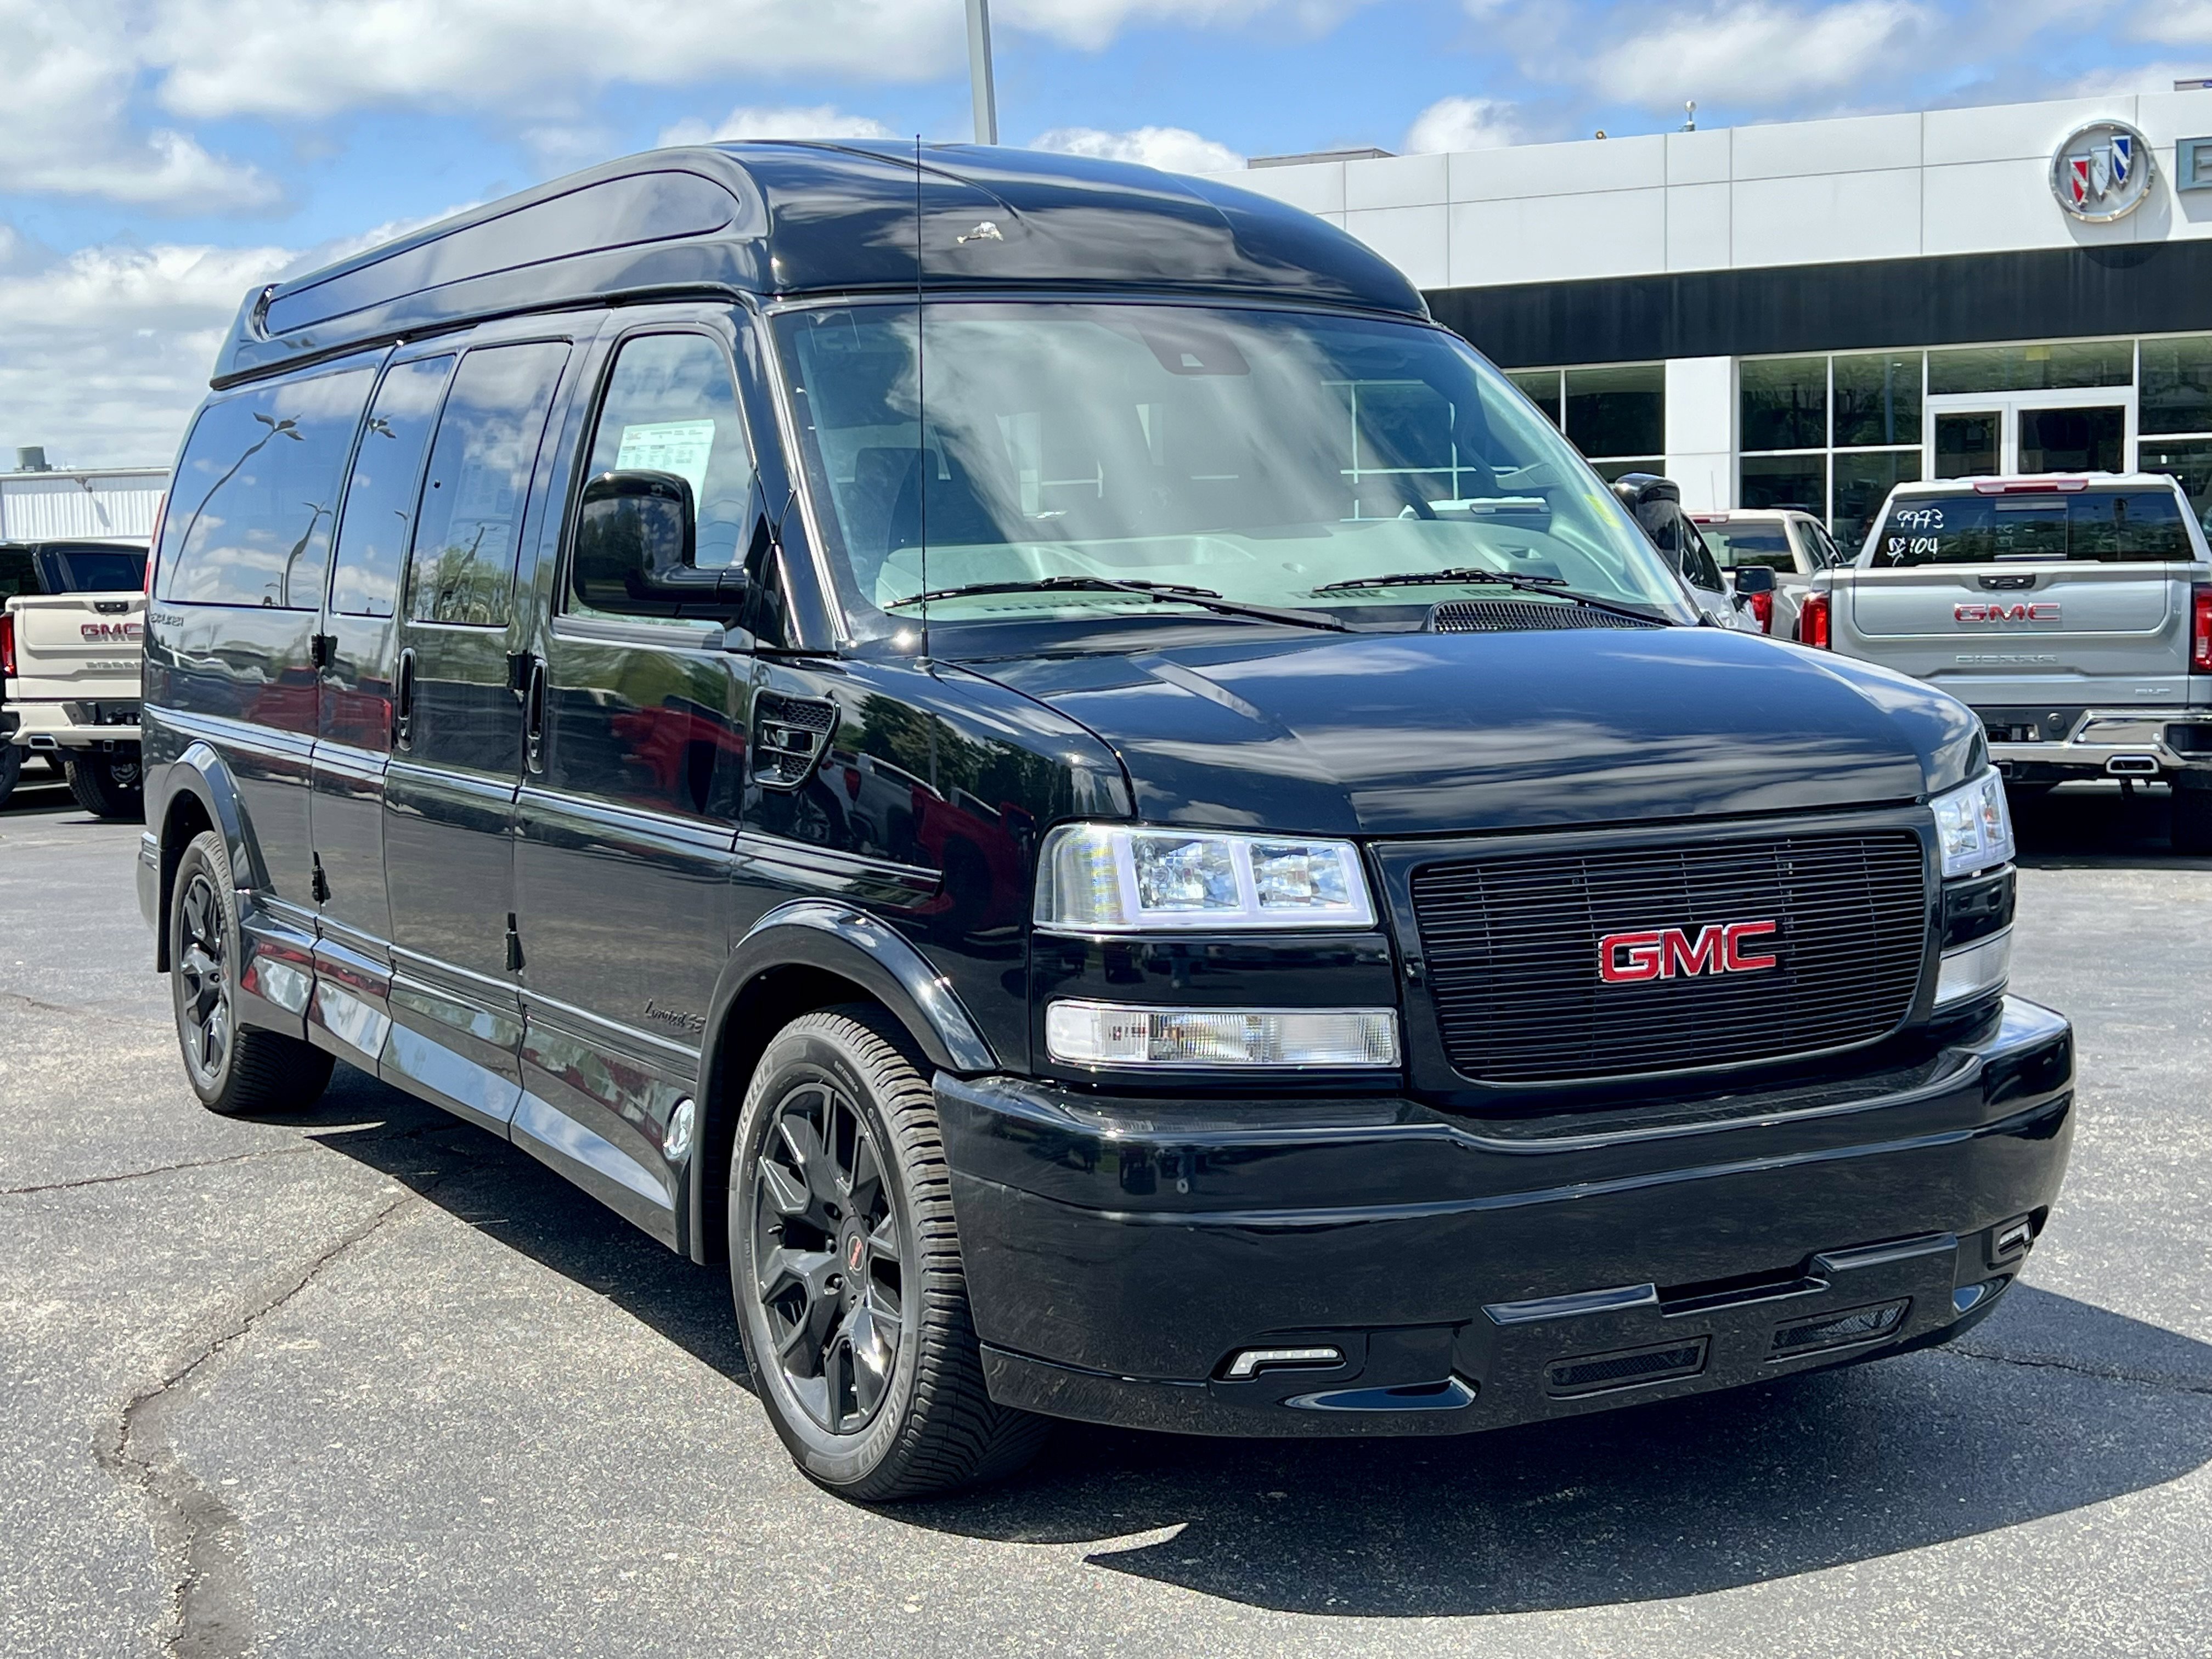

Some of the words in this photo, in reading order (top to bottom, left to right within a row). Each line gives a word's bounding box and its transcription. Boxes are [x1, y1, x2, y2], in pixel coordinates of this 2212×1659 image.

[1954, 602, 2060, 623] GMC
[81, 623, 143, 635] GMC
[1598, 919, 1776, 983] GMC
